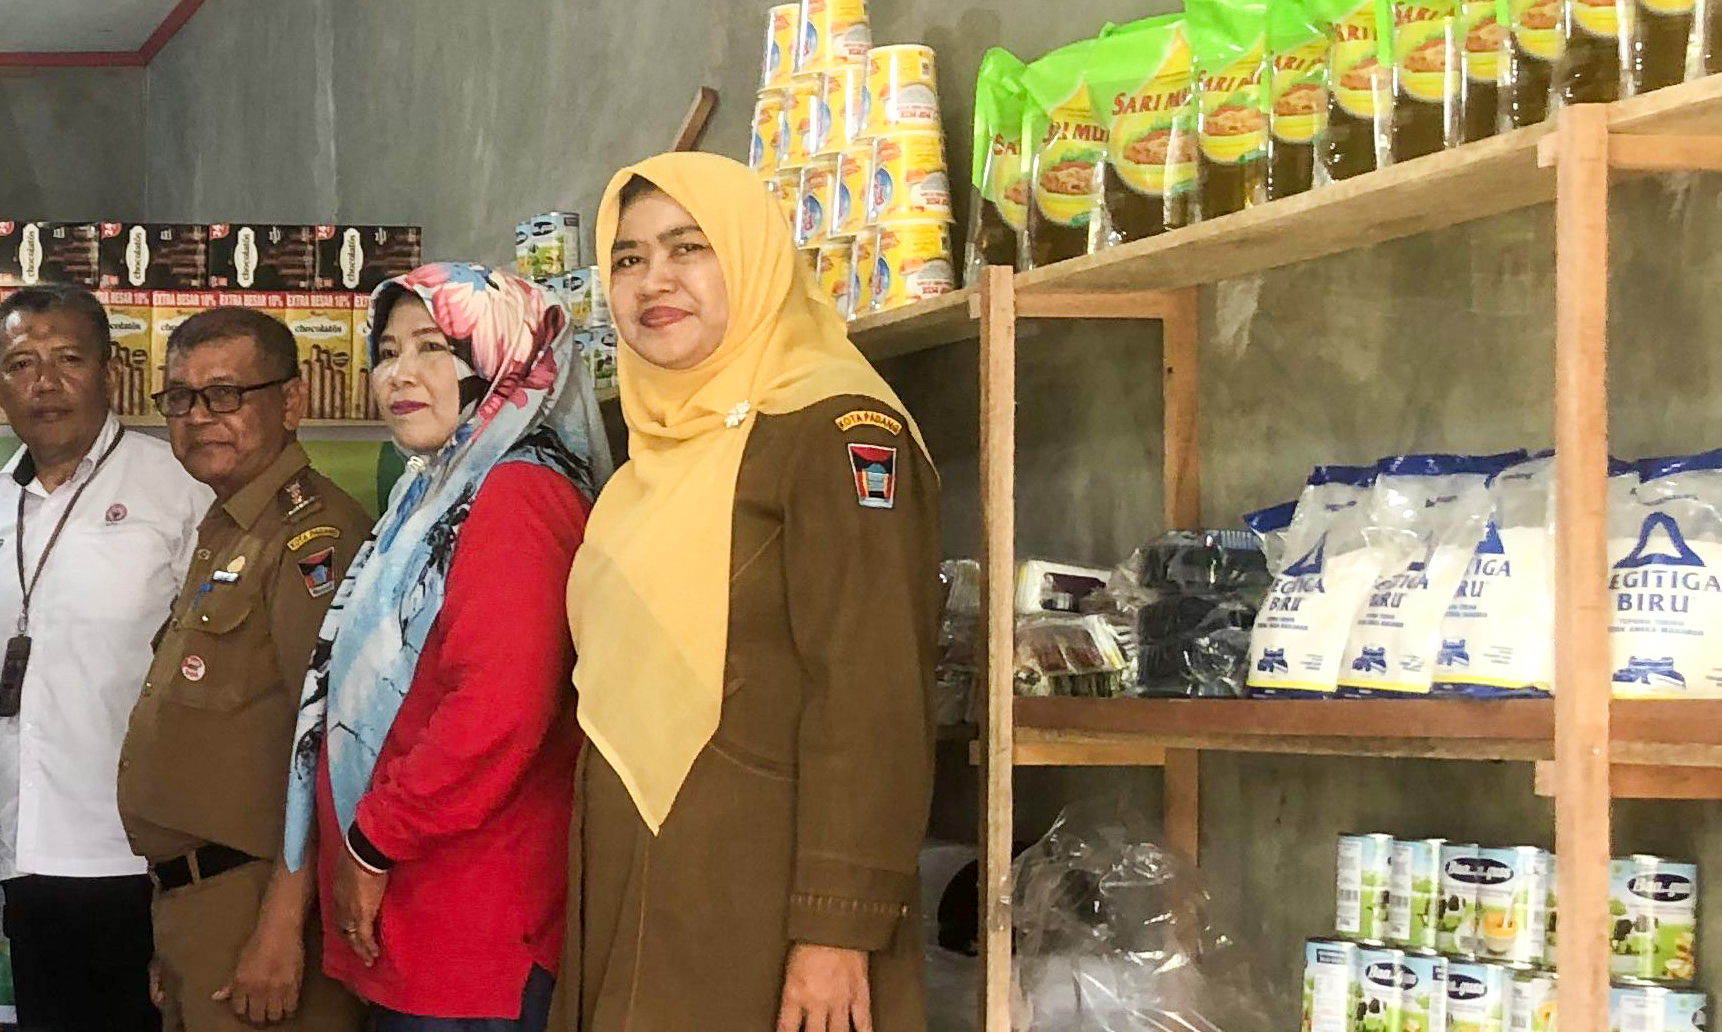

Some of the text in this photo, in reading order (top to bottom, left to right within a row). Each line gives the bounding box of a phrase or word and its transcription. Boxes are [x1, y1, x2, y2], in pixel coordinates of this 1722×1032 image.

[1112, 91, 1162, 116] SARI
[1609, 570, 1722, 592] EGITIGA
[1617, 593, 1689, 613] BIRU
